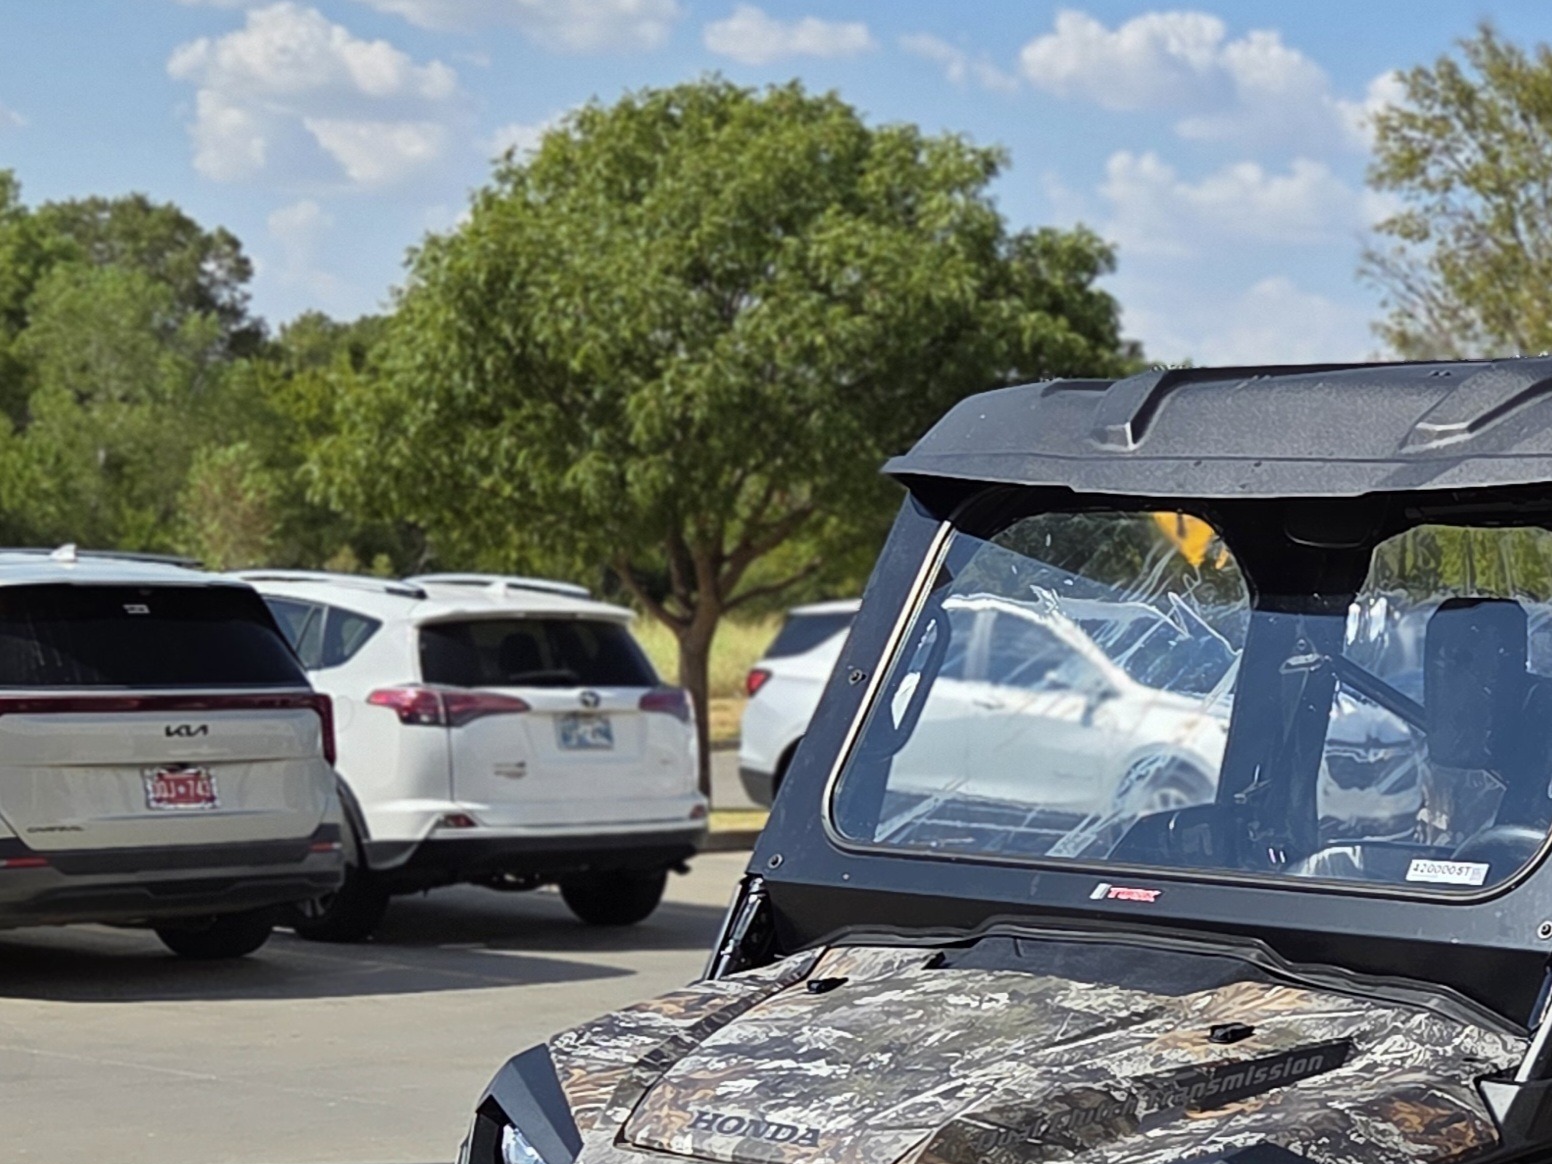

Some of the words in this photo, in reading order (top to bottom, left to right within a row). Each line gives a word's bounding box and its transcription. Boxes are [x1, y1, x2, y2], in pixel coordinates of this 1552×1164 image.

[165, 724, 209, 737] KIA
[1147, 1054, 1324, 1105] Transmission
[688, 1110, 820, 1147] HONDA
